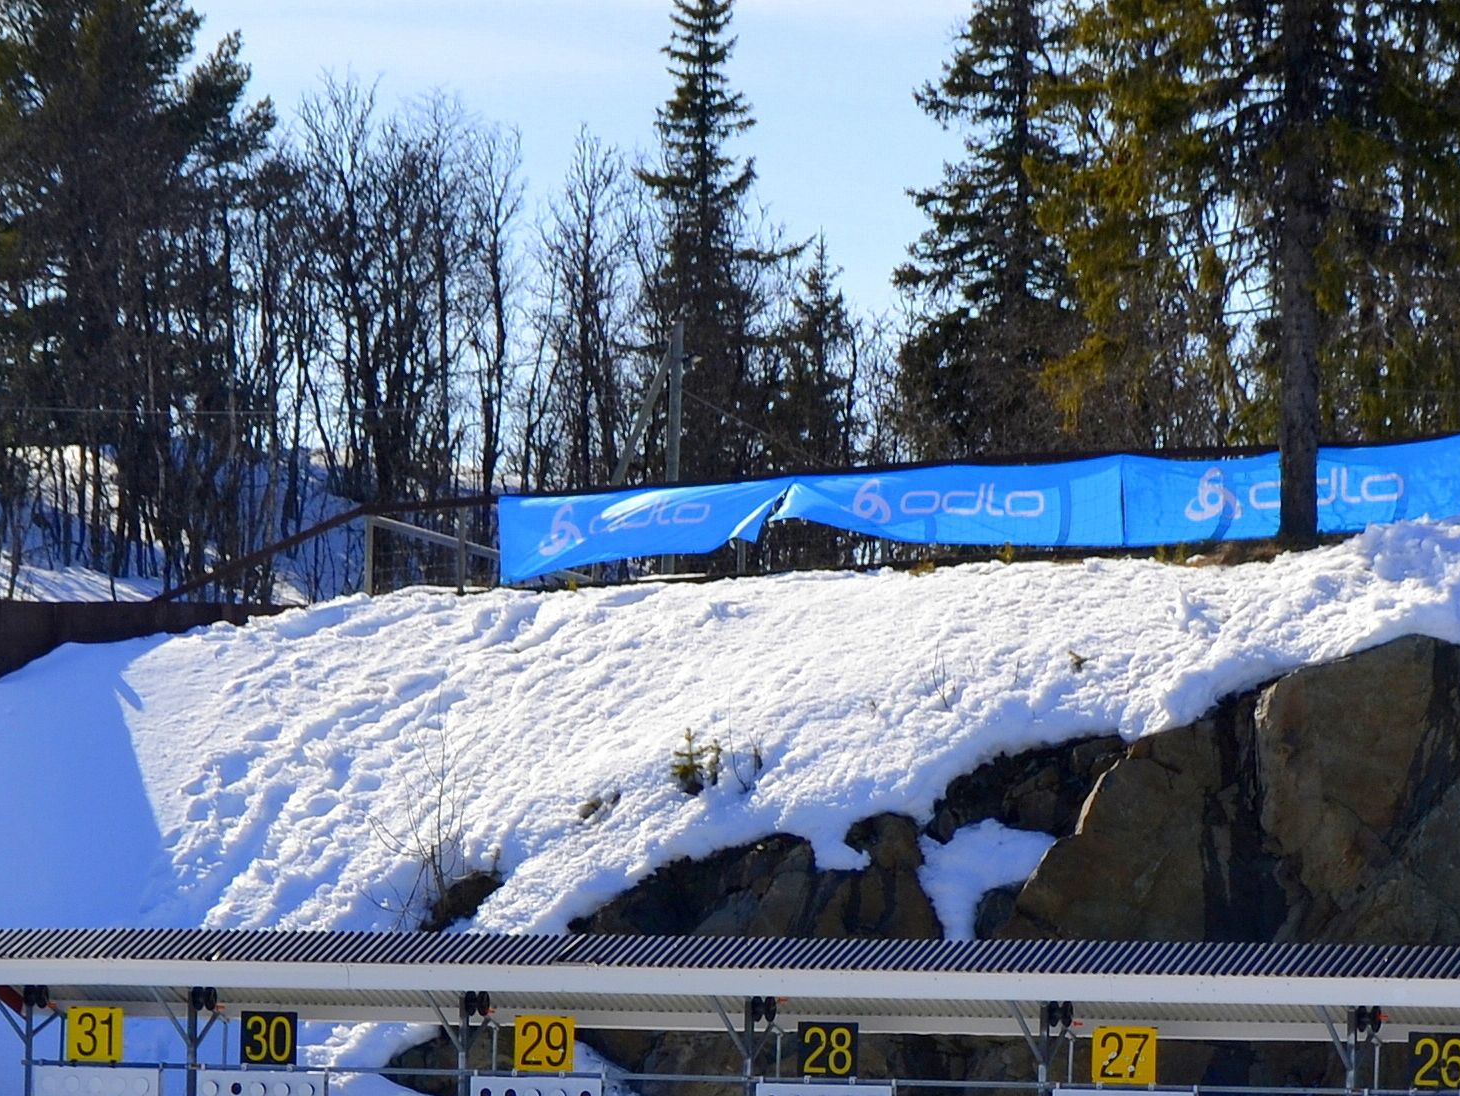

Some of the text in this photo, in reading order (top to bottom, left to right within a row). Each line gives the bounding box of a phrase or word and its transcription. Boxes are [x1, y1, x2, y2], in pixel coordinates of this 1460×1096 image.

[900, 483, 1045, 518] odlo
[76, 1012, 115, 1057] 31
[245, 1015, 291, 1062] 30
[520, 1022, 569, 1067] 29
[803, 1027, 852, 1075] 28
[1099, 1032, 1150, 1079] 27
